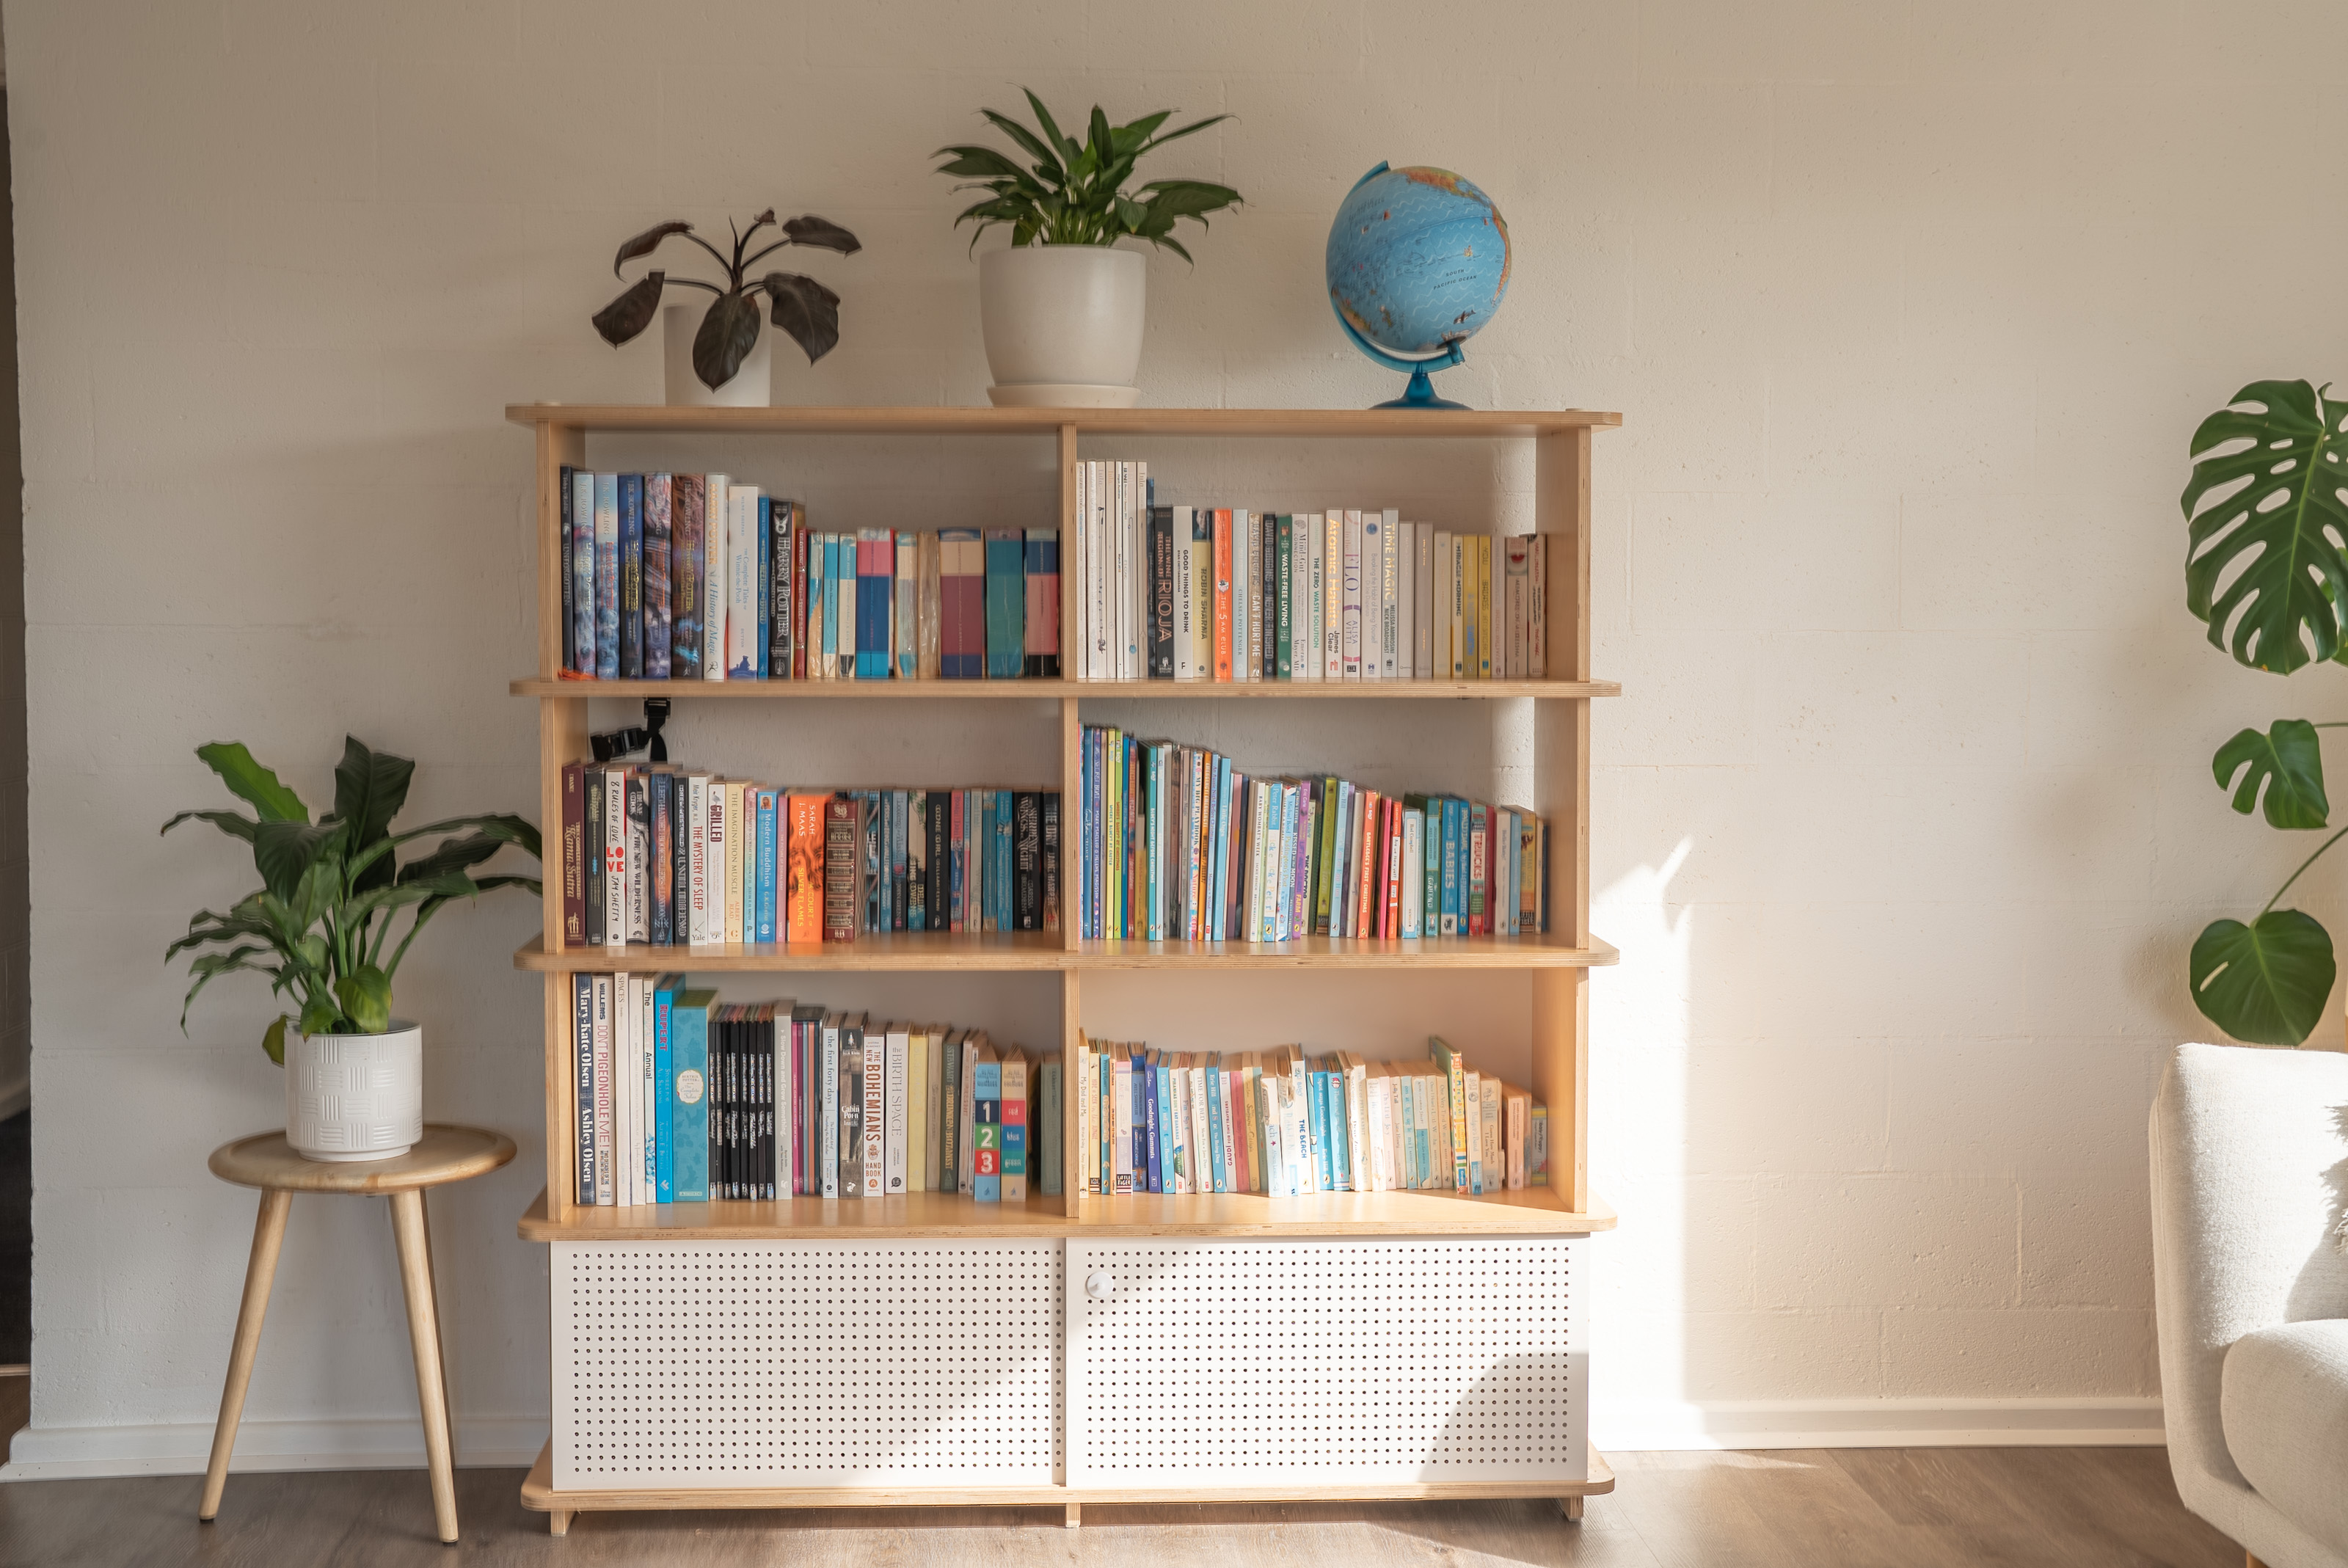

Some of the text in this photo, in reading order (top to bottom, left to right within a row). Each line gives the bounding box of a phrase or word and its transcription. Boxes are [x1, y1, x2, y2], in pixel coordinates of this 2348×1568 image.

[1434, 279, 1456, 290] PACIFIC
[1445, 269, 1465, 277] SOUTH
[709, 484, 718, 564] HARRY POTTER
[1327, 519, 1341, 627] Atomic Habits
[1344, 553, 1359, 591] FLO
[1385, 522, 1395, 600] TIME MAGIC
[777, 536, 790, 640] HARRY POTTER
[707, 589, 718, 616] History
[1158, 580, 1172, 643] RIOJA
[1183, 600, 1189, 610] TO
[707, 619, 718, 630] of
[1252, 595, 1261, 657] CAN'T HURT ME
[707, 630, 717, 656] Magic
[1196, 777, 1201, 788] MY
[611, 790, 619, 813] RULES
[1271, 805, 1279, 825] Rabbit
[611, 815, 619, 823] OF
[710, 805, 722, 842] GRILLED
[693, 826, 703, 910] THE MYSTERY OF SLEEP
[1283, 836, 1291, 872] Paddington's
[1445, 840, 1456, 889] BABIES
[1473, 833, 1483, 879] TRUCKS
[611, 892, 619, 922] SHETTY
[597, 1025, 608, 1050] DON'T
[659, 1004, 668, 1052] RUPERT
[578, 986, 594, 1183] Mary-Kate Olsen Ashley Olsen
[598, 1052, 609, 1118] PIGEONHOLE
[825, 1068, 834, 1086] forty
[1080, 1076, 1086, 1085] My
[825, 1088, 834, 1104] days
[865, 1064, 880, 1141] BOHEMIANS
[892, 1054, 902, 1136] BIRTH SPACE
[983, 1101, 990, 1123] 1
[1080, 1109, 1087, 1117] Me
[599, 1120, 610, 1148] ME!
[981, 1128, 993, 1148] 2
[981, 1152, 992, 1173] 3
